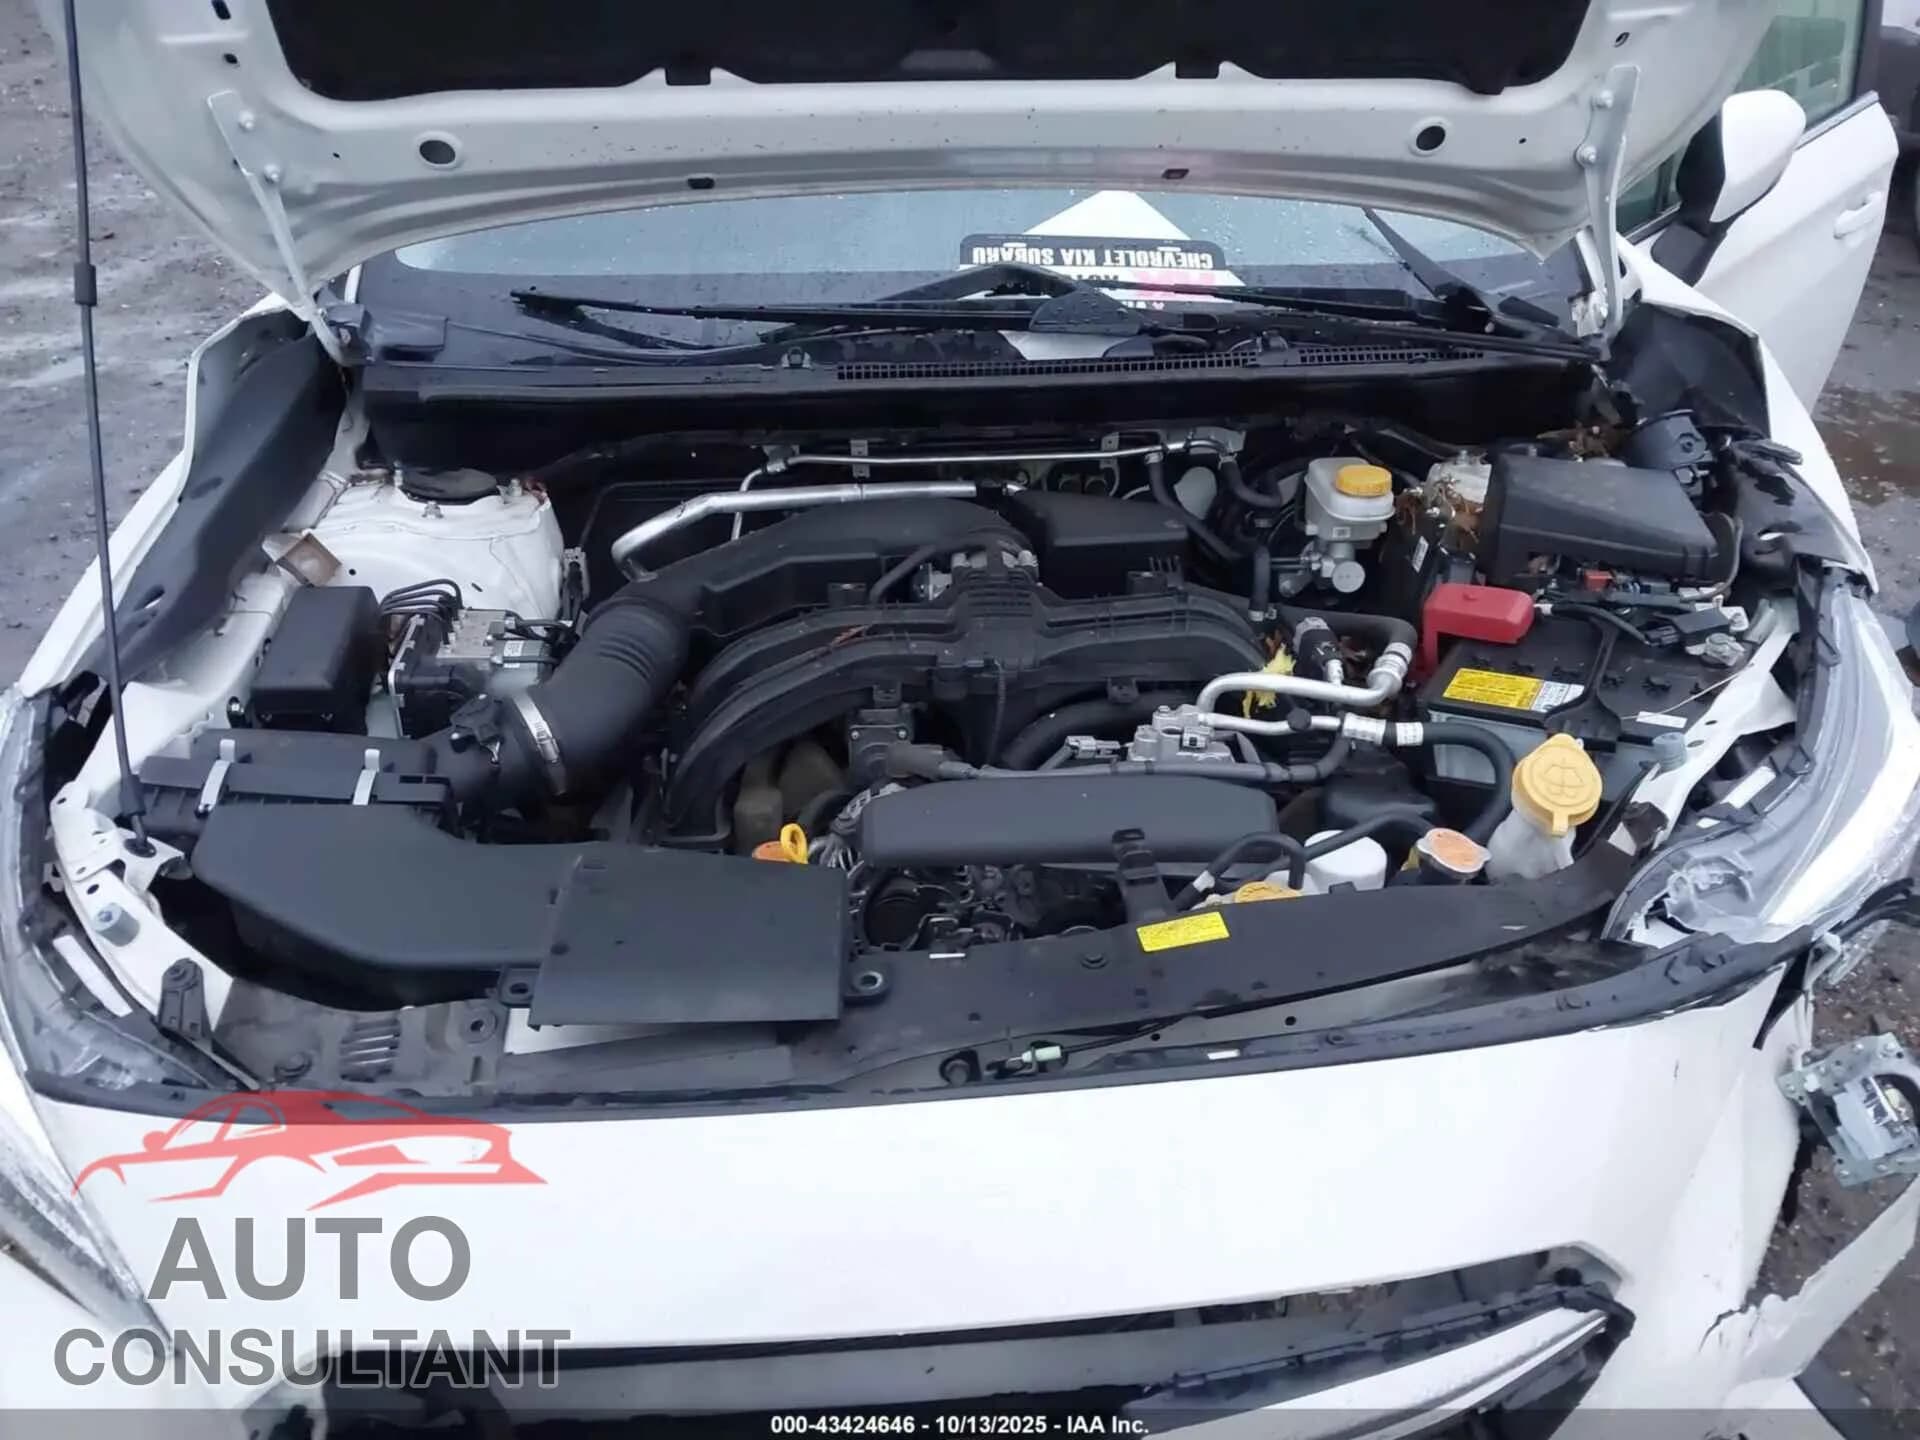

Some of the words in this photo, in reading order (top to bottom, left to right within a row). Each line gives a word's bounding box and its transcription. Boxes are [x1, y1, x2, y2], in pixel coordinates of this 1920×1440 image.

[972, 246, 1054, 266] SUBARU
[1060, 248, 1096, 267] KIA
[1103, 249, 1213, 269] CHEVROLET
